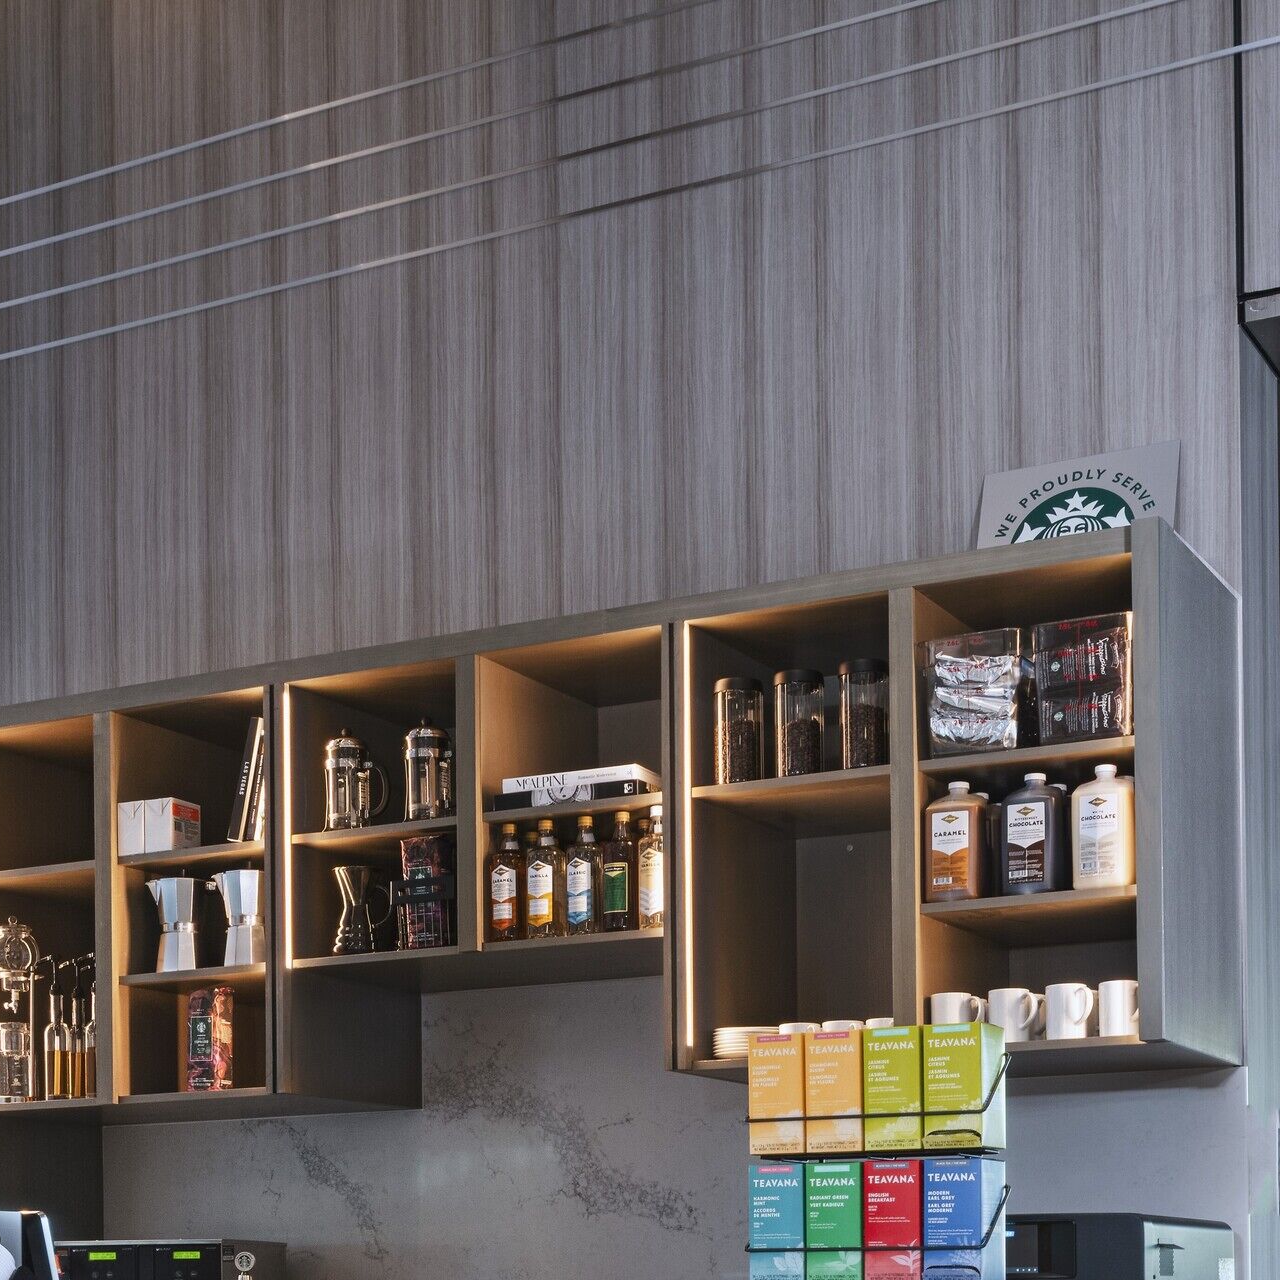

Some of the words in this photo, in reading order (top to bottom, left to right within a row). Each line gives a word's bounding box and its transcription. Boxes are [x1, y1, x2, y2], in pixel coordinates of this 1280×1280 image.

[995, 513, 1018, 538] WE
[1018, 468, 1107, 509] PROUDLY
[1111, 472, 1156, 512] SERVE
[242, 761, 250, 774] LAS
[238, 775, 248, 796] VEGAS
[1080, 814, 1116, 822] CHOCOLATE
[1008, 820, 1044, 828] CHOCOLATE
[933, 830, 967, 838] CARAMEL
[867, 1041, 914, 1051] TEAVANA
[927, 1037, 976, 1048] TEAVANA
[752, 1047, 797, 1057] TEAVANA
[808, 1044, 855, 1055] TEAVANA
[867, 1174, 915, 1184] TEAVANA
[927, 1172, 976, 1182] TEAVANA
[753, 1179, 799, 1188] TEAVANA
[809, 1178, 855, 1187] TEAVANA
